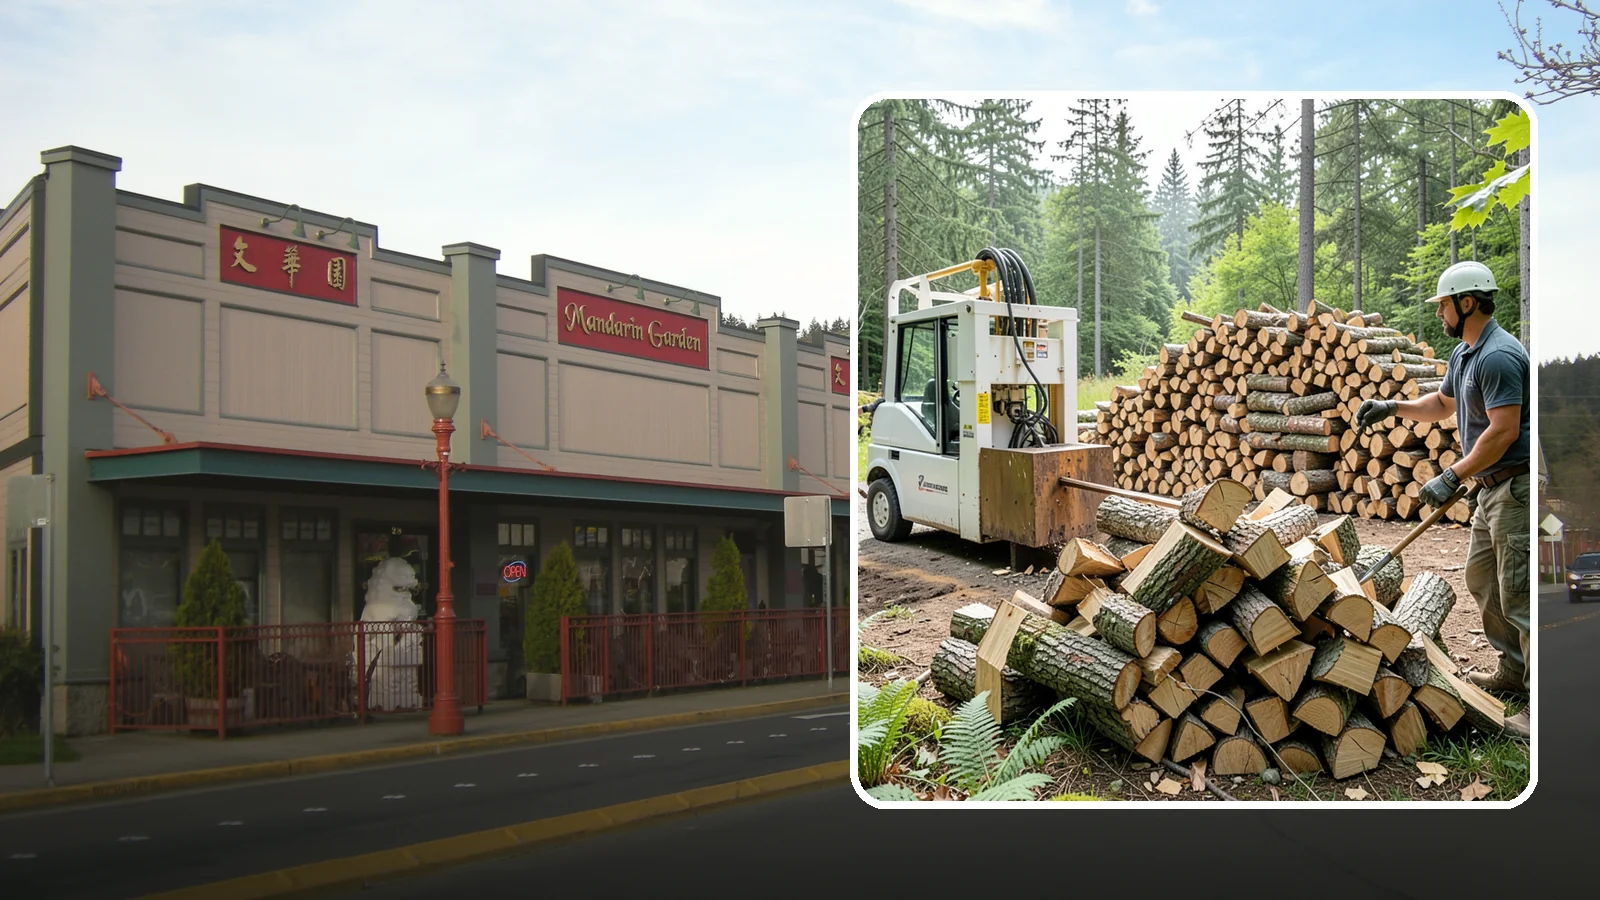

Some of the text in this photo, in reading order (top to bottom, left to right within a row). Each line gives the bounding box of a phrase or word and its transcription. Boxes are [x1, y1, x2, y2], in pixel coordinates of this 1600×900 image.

[231, 235, 347, 291] 文華園
[564, 302, 701, 352] Mandarin Garden
[835, 363, 846, 386] 文
[503, 565, 527, 578] OPEN
